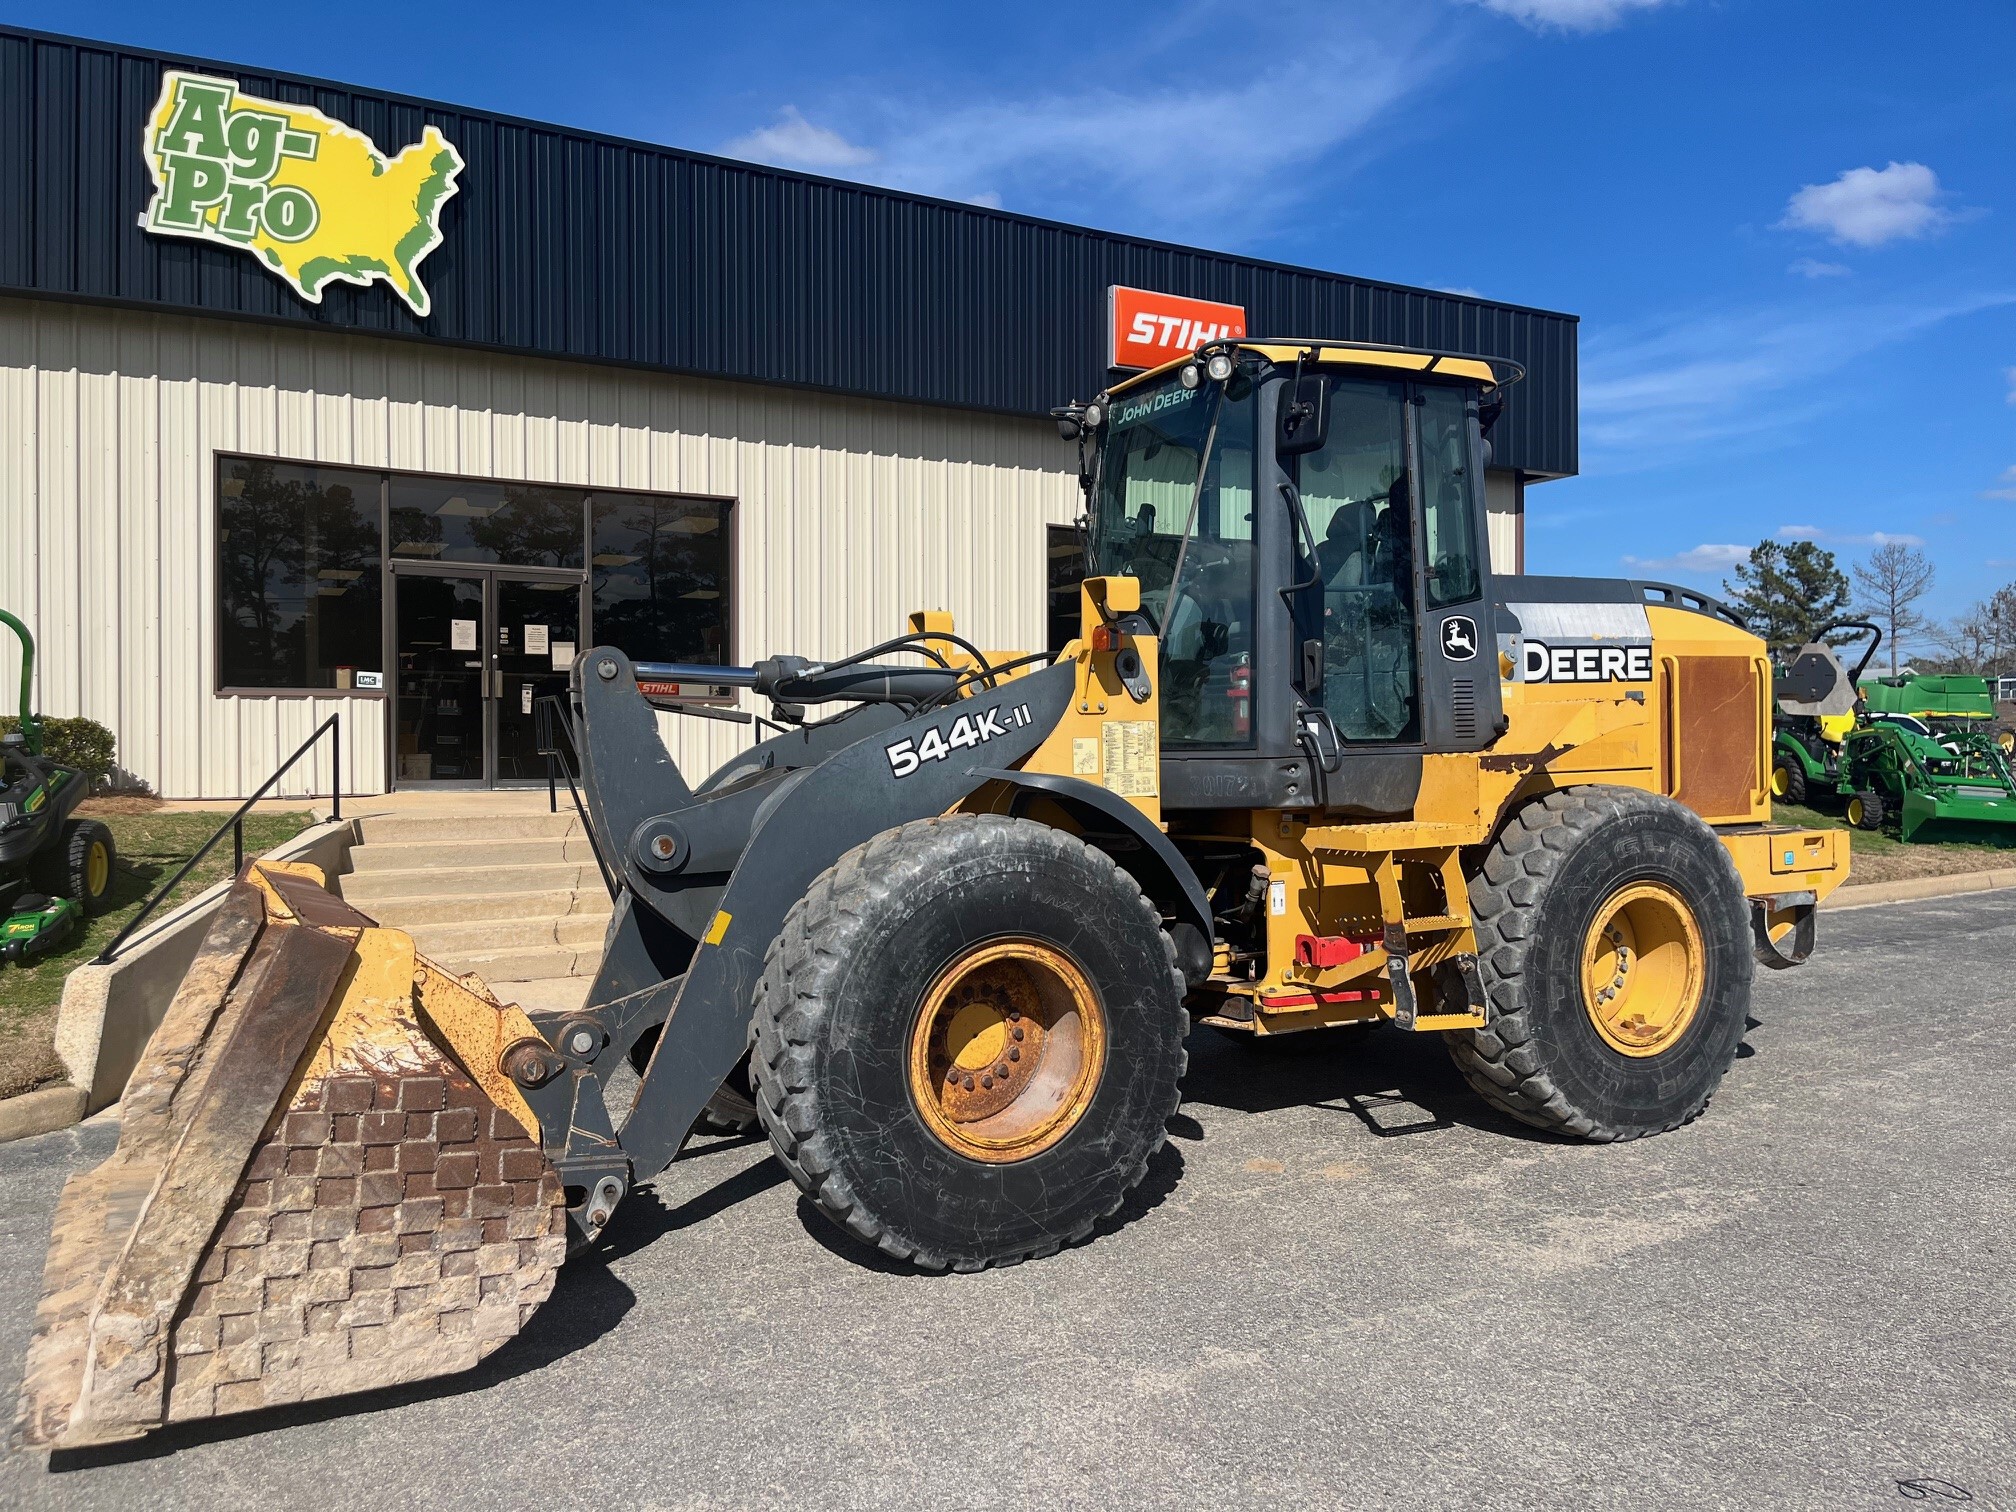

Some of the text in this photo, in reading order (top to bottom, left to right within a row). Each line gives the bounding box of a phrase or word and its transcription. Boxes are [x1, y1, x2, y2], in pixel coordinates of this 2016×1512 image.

[156, 80, 318, 182] Ag-
[155, 154, 319, 242] Pro
[1118, 401, 1152, 424] JOHN
[641, 683, 676, 694] STIHL
[1522, 640, 1651, 682] DEERE
[885, 703, 1033, 779] 544K-II
